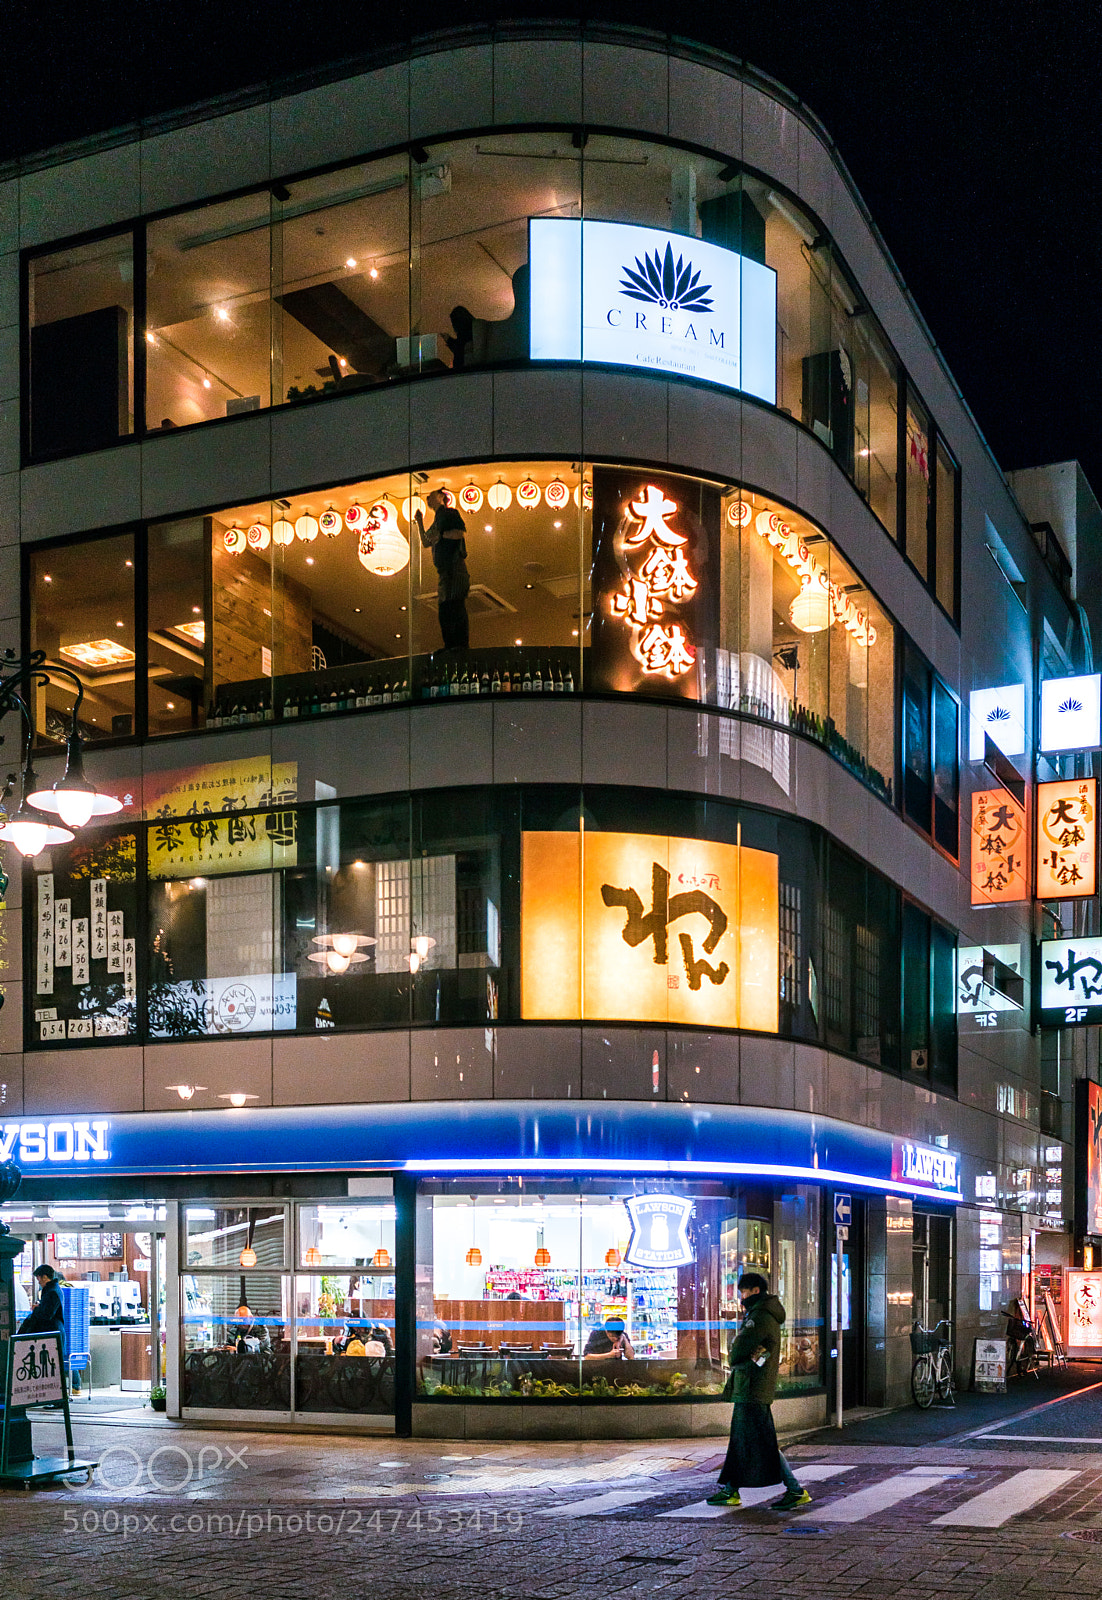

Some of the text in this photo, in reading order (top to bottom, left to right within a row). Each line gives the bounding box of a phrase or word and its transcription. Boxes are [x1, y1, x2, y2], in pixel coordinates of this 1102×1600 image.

[606, 308, 725, 349] CREAM
[610, 484, 698, 677] 大鉢小鉢
[1042, 799, 1085, 886] 大鉢小鉢
[41, 877, 52, 989] ご予約承ります
[58, 902, 69, 961] 個室26席
[94, 882, 105, 954] 種類豊富な
[110, 914, 121, 968] 飲み放題
[601, 861, 730, 991] わん
[76, 920, 86, 980] 最大56名
[125, 942, 134, 997] あります
[1045, 948, 1102, 1000] わん
[38, 1010, 54, 1021] TEL
[42, 1022, 63, 1037] 054
[70, 1022, 91, 1034] 205
[1065, 1008, 1088, 1023] 2F
[904, 1144, 957, 1187] LAWSON
[635, 1202, 685, 1216] LAWSON
[635, 1248, 684, 1261] STATION
[976, 1363, 996, 1376] 4F
